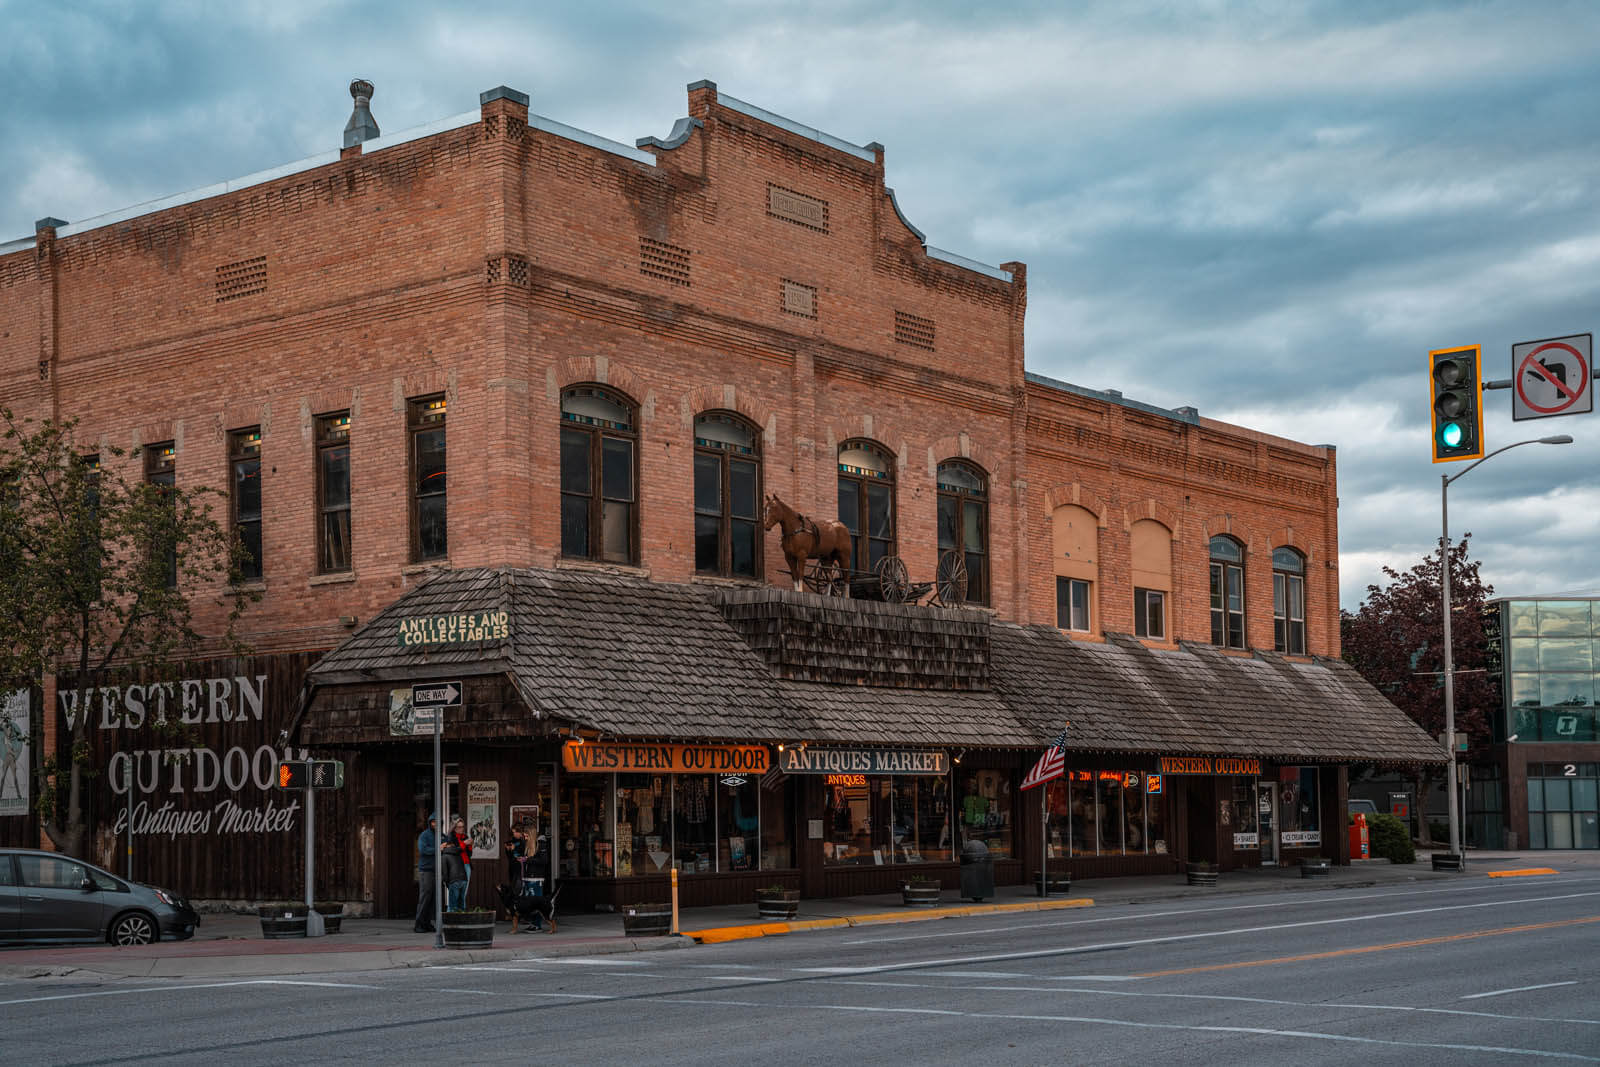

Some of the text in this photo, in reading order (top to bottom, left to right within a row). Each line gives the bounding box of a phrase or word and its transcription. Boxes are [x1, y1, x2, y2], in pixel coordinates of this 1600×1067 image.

[399, 611, 509, 634] ANTIQUES AND
[404, 624, 509, 646] COLLECTABLES
[58, 674, 269, 732] WESTERN
[417, 690, 447, 700] ONE WAY
[569, 745, 766, 770] WESTERN OUTDOOR
[787, 749, 943, 773] ANTIQUES MARKET
[1160, 756, 1261, 775] WESTERN OUTDOOR
[828, 774, 866, 786] ANTIQUES
[1563, 763, 1577, 776] 2
[113, 798, 301, 841] & Antiques Market
